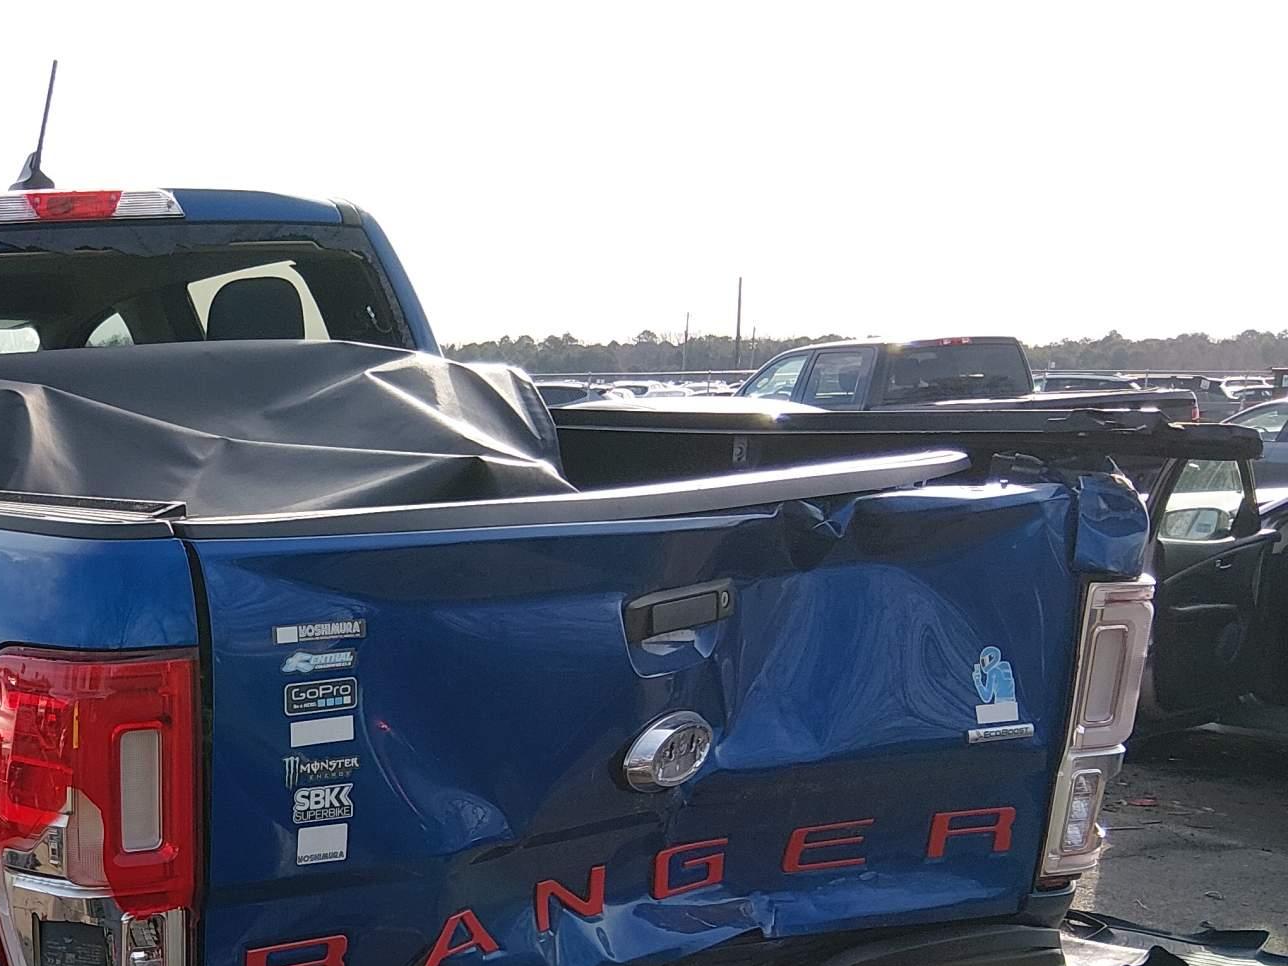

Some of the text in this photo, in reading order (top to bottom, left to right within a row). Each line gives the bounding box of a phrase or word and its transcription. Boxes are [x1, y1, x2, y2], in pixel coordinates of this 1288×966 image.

[291, 685, 352, 701] GoPro
[299, 757, 360, 774] MONSTER
[295, 806, 351, 821] SUPERBIKE
